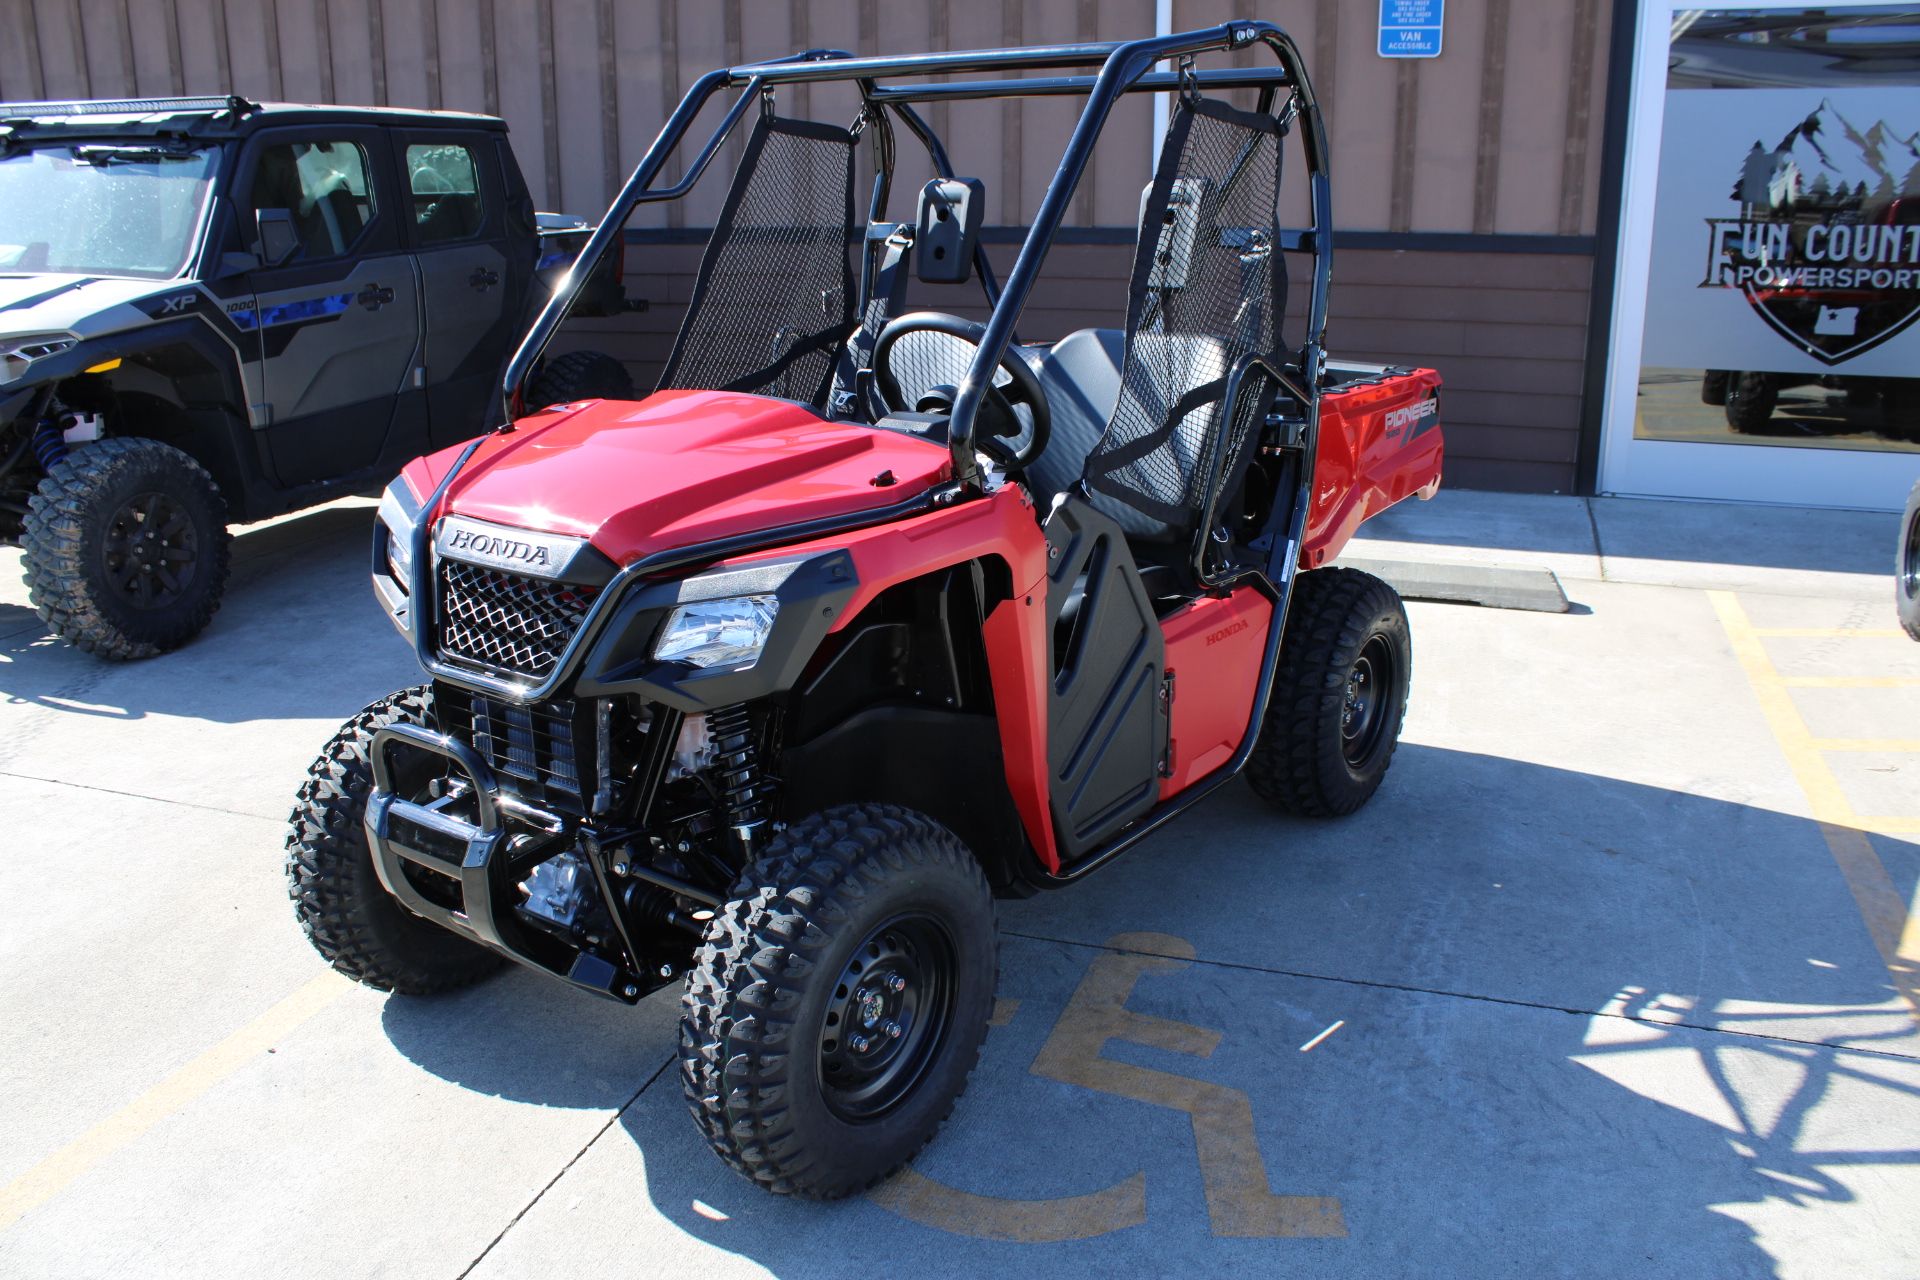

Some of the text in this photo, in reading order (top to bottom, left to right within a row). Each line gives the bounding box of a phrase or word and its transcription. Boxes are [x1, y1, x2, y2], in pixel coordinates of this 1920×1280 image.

[1388, 41, 1432, 50] ACCESSIBLE
[1400, 31, 1421, 41] VAN
[1704, 220, 1790, 286] FUN
[162, 294, 254, 313] XP 1000
[1384, 397, 1437, 431] PIONEER
[449, 529, 551, 566] HONDA
[1206, 619, 1249, 646] HONDA
